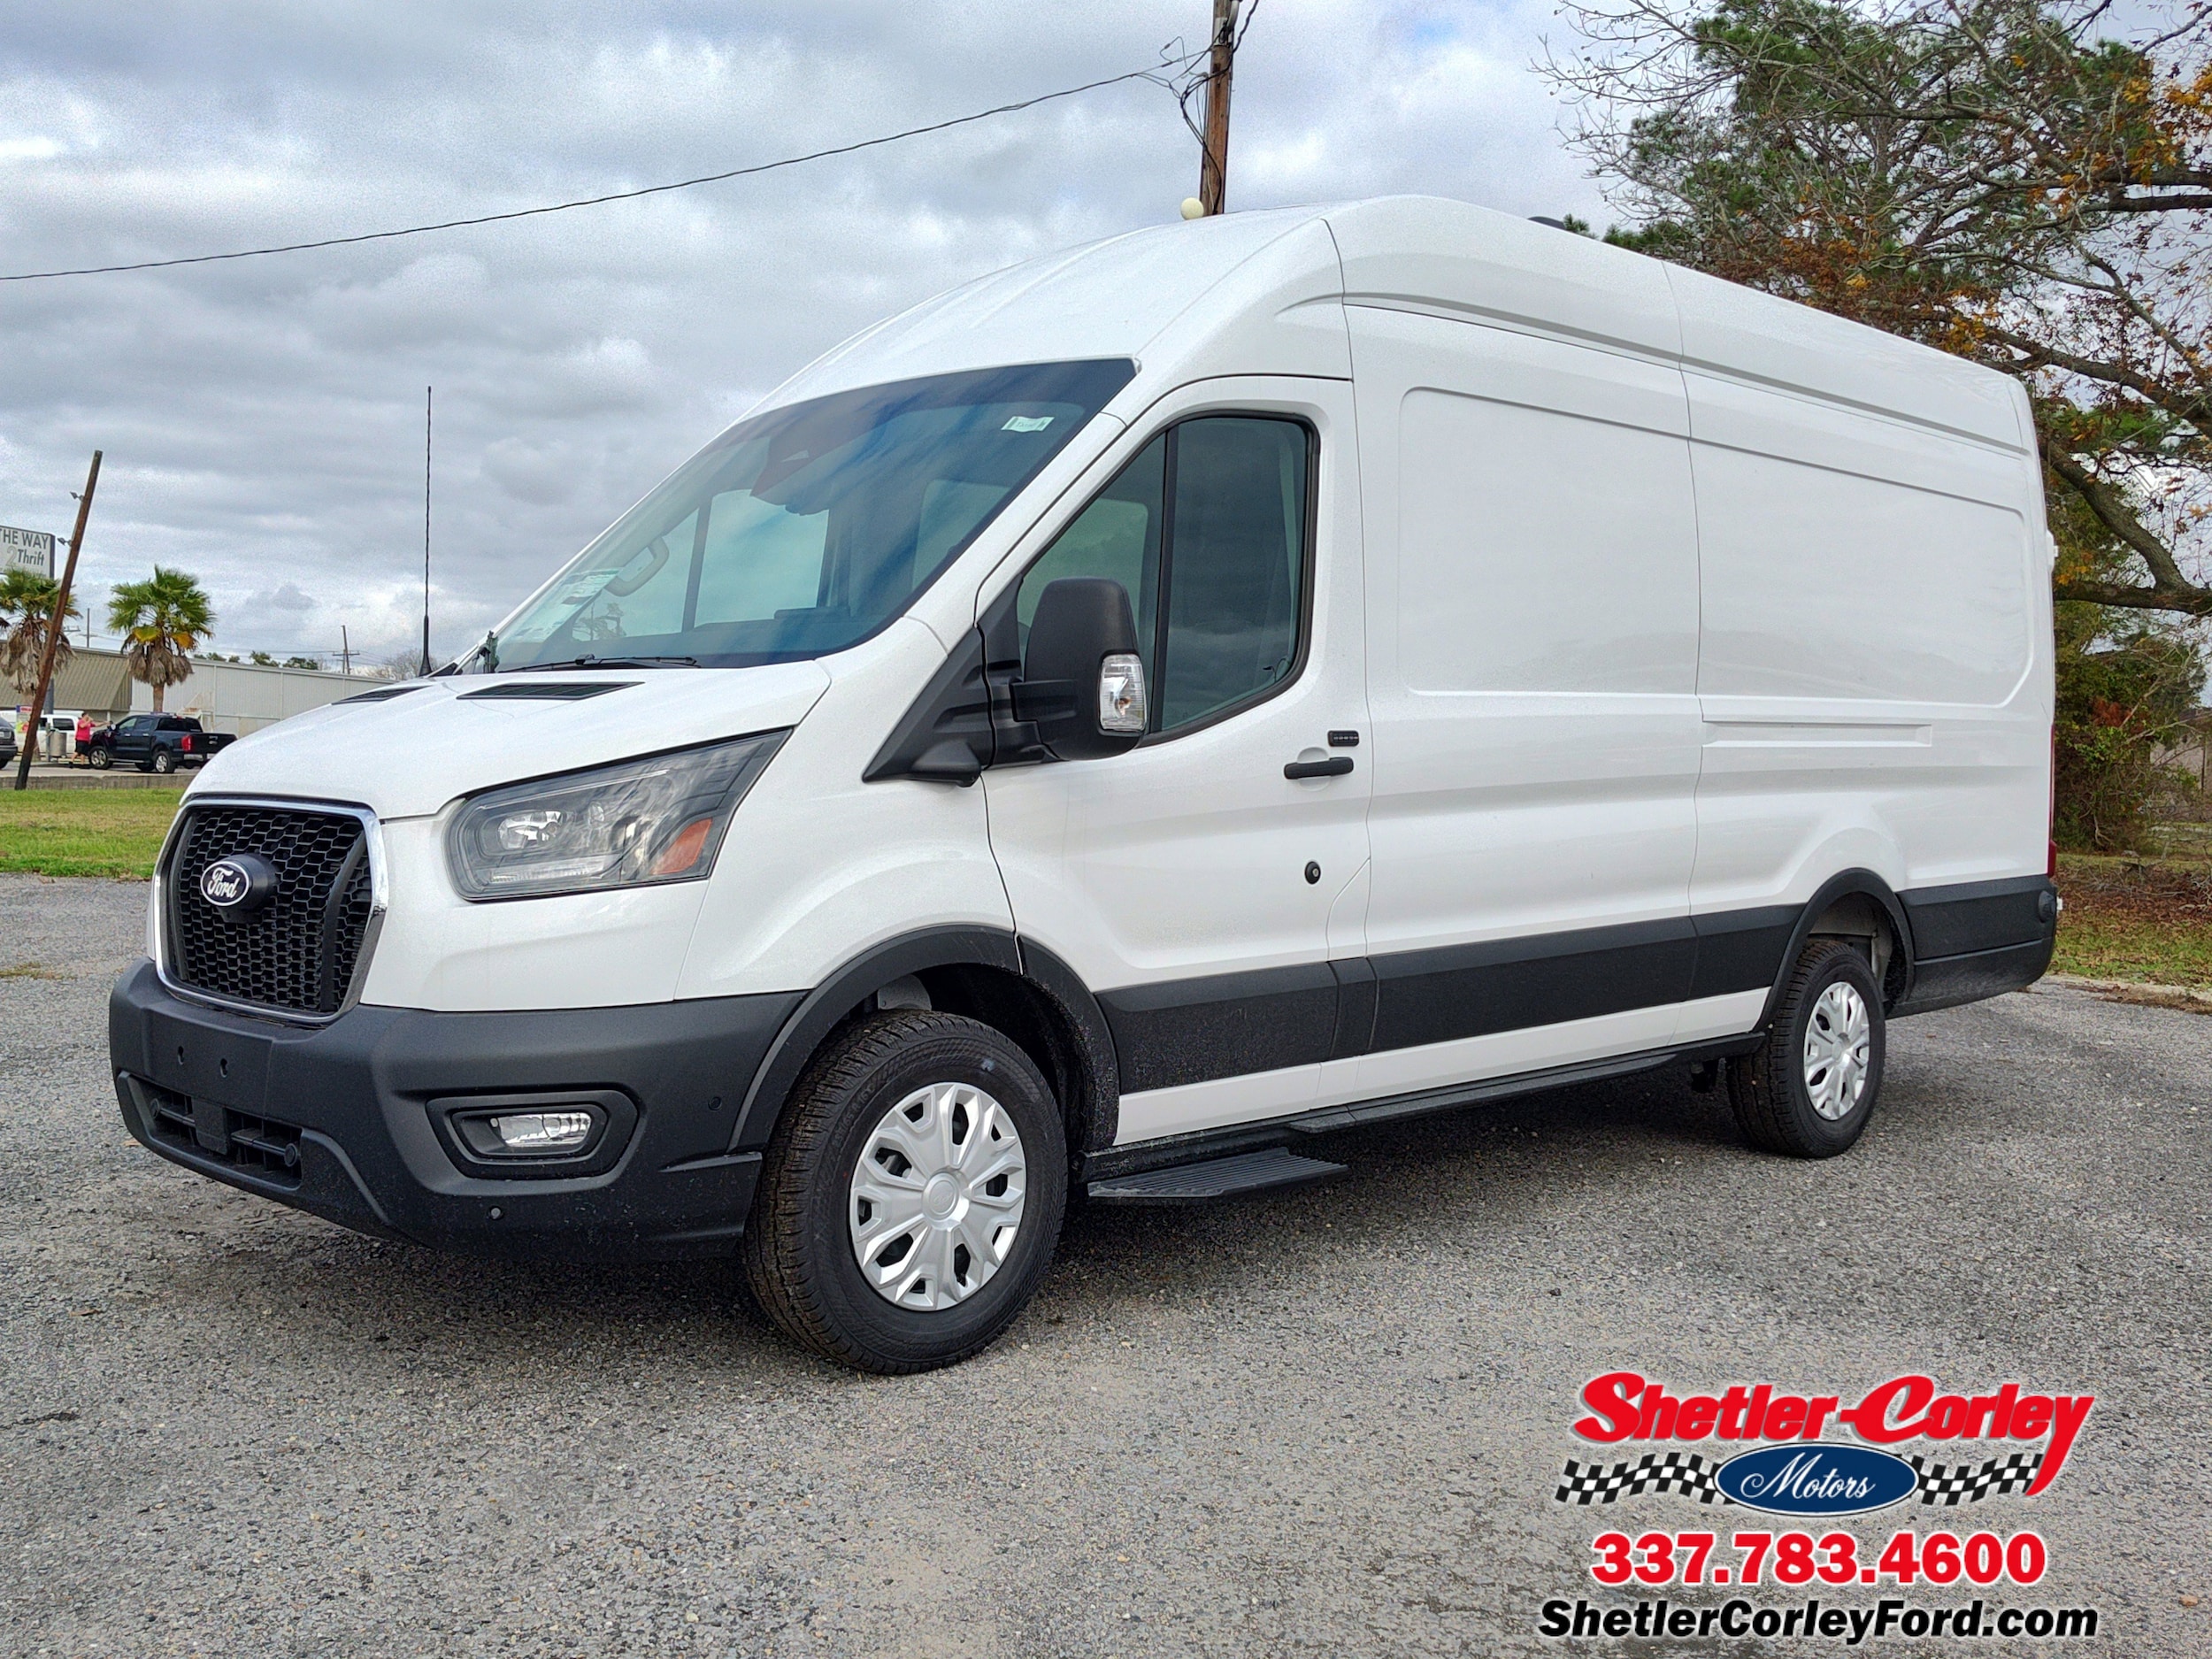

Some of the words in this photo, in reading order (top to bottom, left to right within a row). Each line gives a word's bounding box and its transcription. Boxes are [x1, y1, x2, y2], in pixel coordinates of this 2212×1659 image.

[0, 528, 18, 545] HE
[22, 532, 49, 549] WAY
[18, 549, 44, 566] Thrift
[207, 867, 241, 899] Ford
